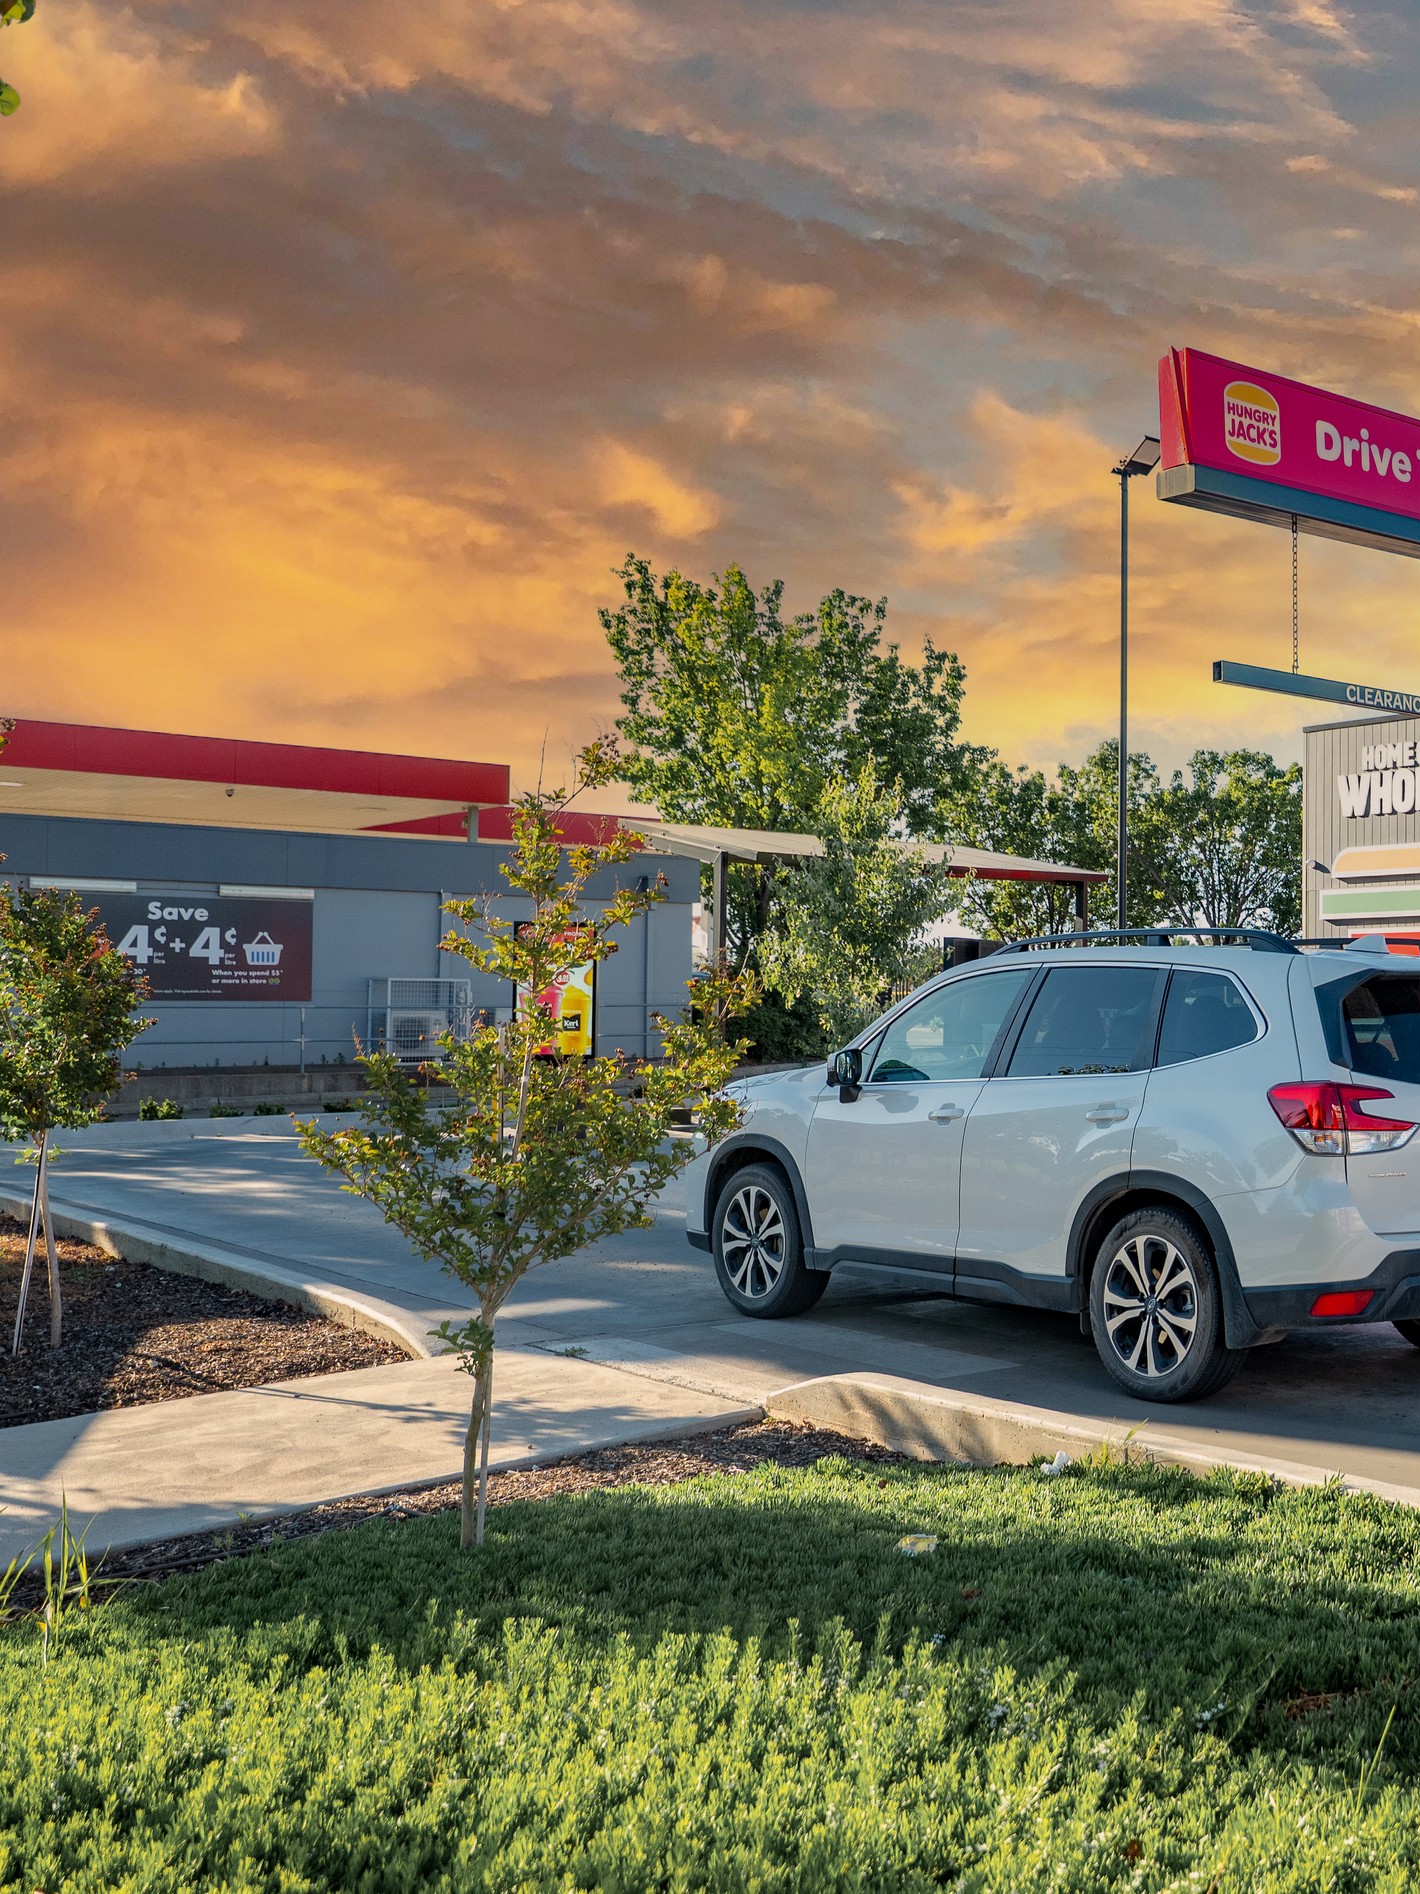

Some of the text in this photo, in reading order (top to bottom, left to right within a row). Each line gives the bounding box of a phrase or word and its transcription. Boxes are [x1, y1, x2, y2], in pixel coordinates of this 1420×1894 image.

[1226, 401, 1277, 428] HUNGRY
[1228, 417, 1278, 449] JACK'S
[1315, 419, 1412, 483] Drive
[1363, 741, 1415, 771] HOME
[147, 901, 209, 922] Save
[249, 969, 270, 977] spend
